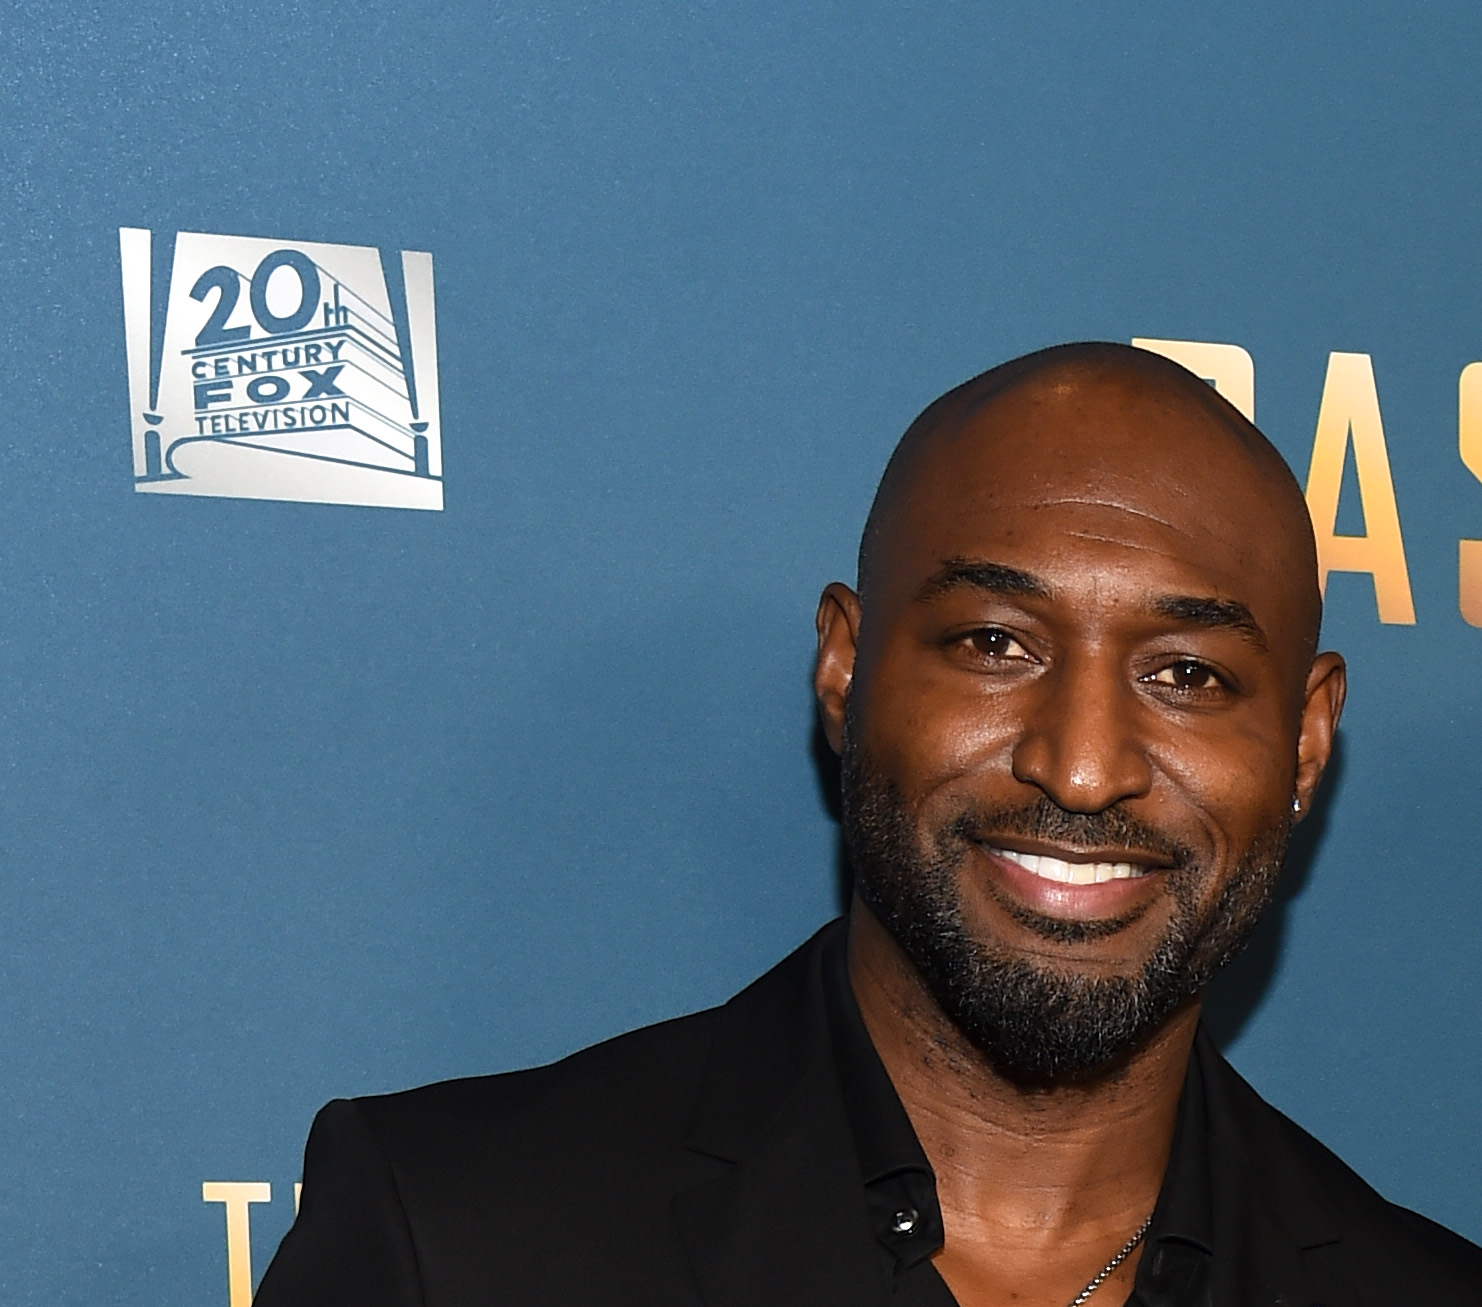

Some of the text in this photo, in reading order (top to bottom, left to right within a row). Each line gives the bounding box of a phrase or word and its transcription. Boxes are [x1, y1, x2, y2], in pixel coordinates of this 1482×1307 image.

[188, 248, 349, 348] 20th
[191, 339, 347, 379] CENTURY
[194, 366, 346, 410] FOX
[195, 402, 350, 434] TELEVISION
